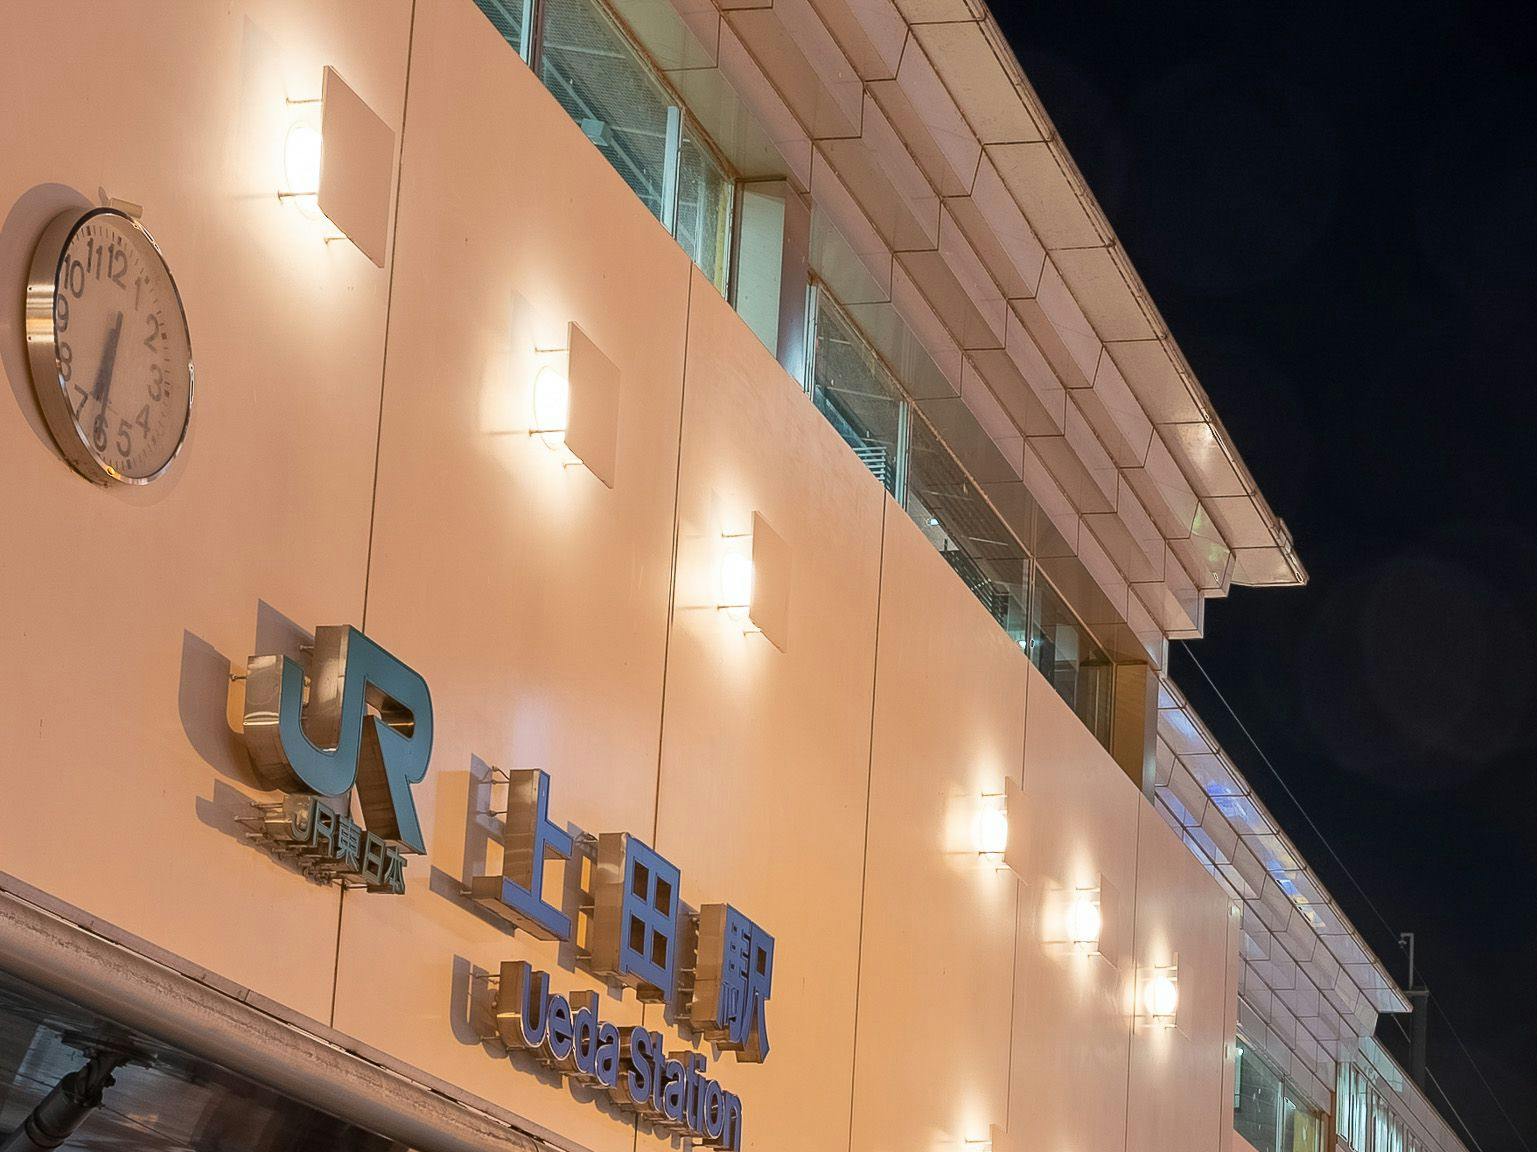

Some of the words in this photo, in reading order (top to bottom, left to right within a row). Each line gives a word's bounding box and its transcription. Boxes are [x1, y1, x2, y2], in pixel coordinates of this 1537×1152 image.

[64, 254, 86, 299] 10
[86, 237, 104, 281] 11
[107, 243, 128, 290] 12
[55, 293, 70, 332] 9
[134, 274, 146, 311] 1
[142, 312, 162, 353] 2
[58, 341, 73, 383] 8
[72, 384, 89, 421] 7
[147, 364, 164, 402] 3
[92, 414, 108, 453] 6
[115, 418, 133, 458] 5
[134, 404, 151, 440] 4
[289, 796, 408, 896] JR東日本
[496, 768, 776, 1062] 上田駅
[510, 961, 621, 1089] Ueda
[621, 1025, 744, 1152] Station
